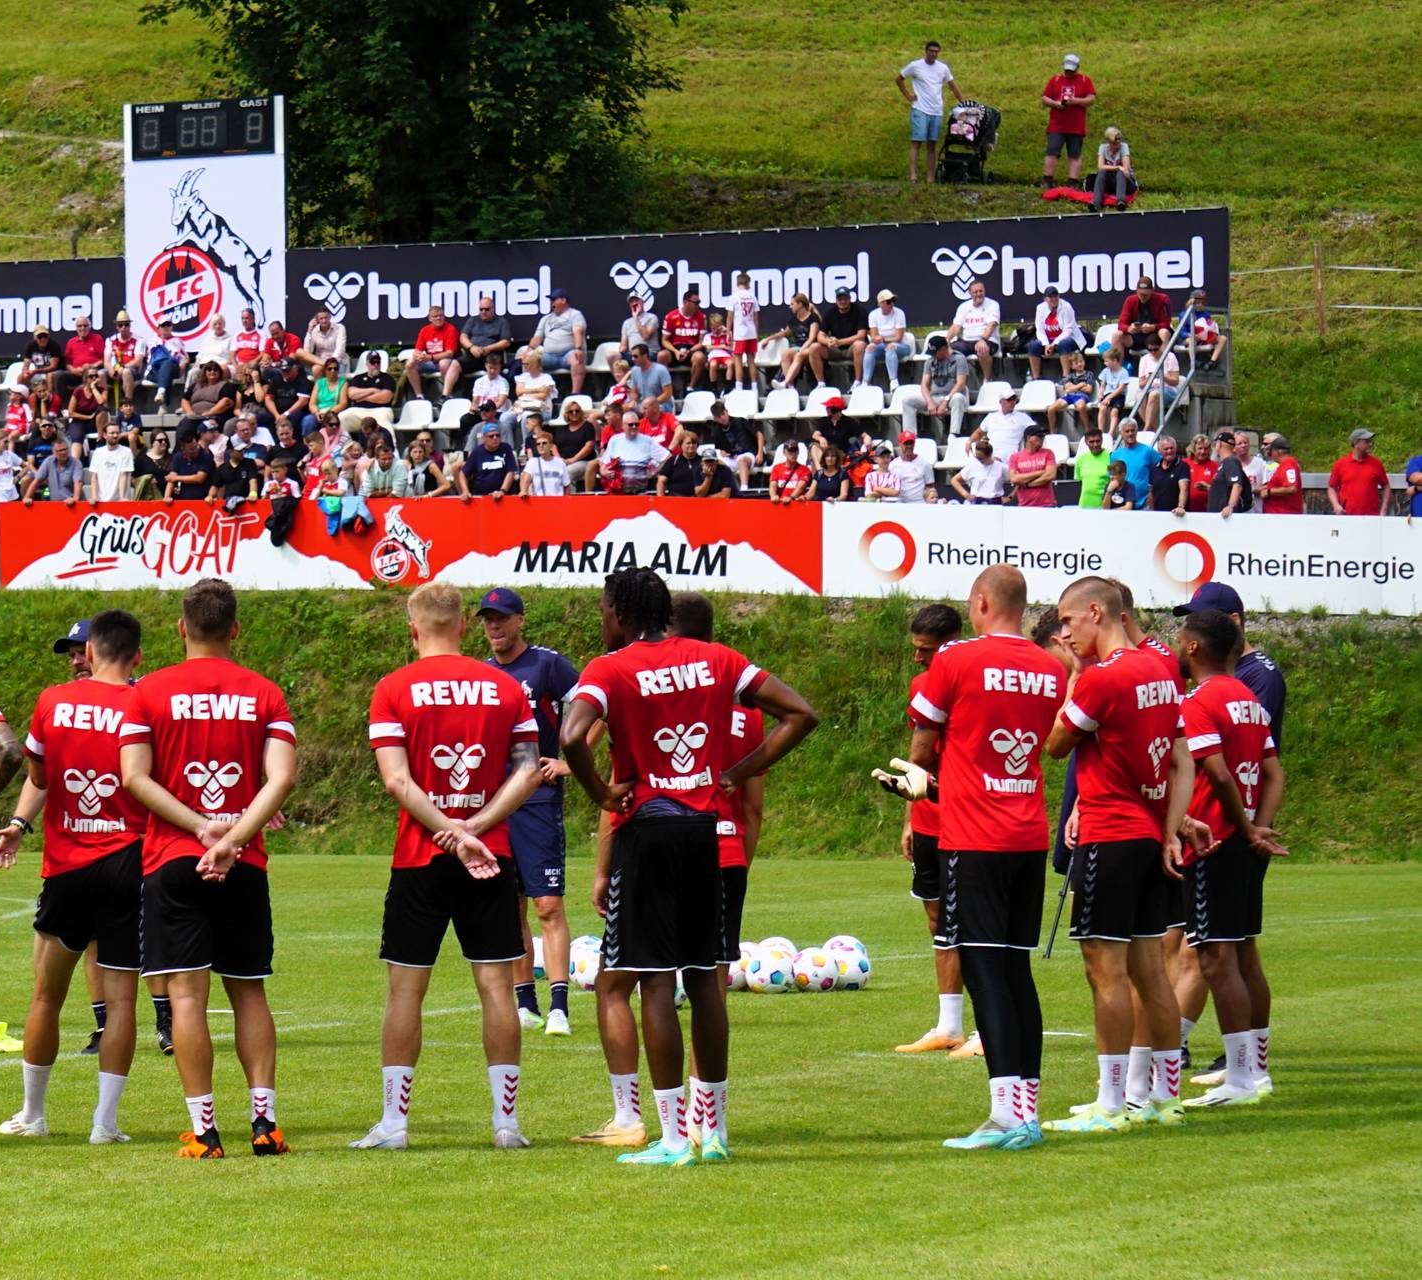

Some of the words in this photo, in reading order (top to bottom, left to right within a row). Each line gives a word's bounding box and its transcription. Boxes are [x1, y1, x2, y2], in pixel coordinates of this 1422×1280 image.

[135, 104, 165, 114] HEIM
[181, 101, 222, 111] SPIELZEIT
[239, 98, 270, 108] GAST
[677, 252, 869, 308] hummel
[1001, 236, 1203, 296] hummel
[157, 275, 204, 308] 1.FC
[368, 265, 551, 320] hummel
[514, 542, 638, 574] MARIA
[650, 542, 728, 577] ALM
[927, 541, 1103, 577] RheinEnergie
[1227, 551, 1416, 588] RheinEnergie
[410, 680, 501, 708] REWE
[636, 661, 716, 697] REWE
[983, 667, 1058, 699] REWE
[53, 703, 123, 734] REW
[171, 693, 257, 722] REWE
[649, 766, 713, 791] hummel
[982, 773, 1038, 794] humme
[427, 790, 486, 810] hummel
